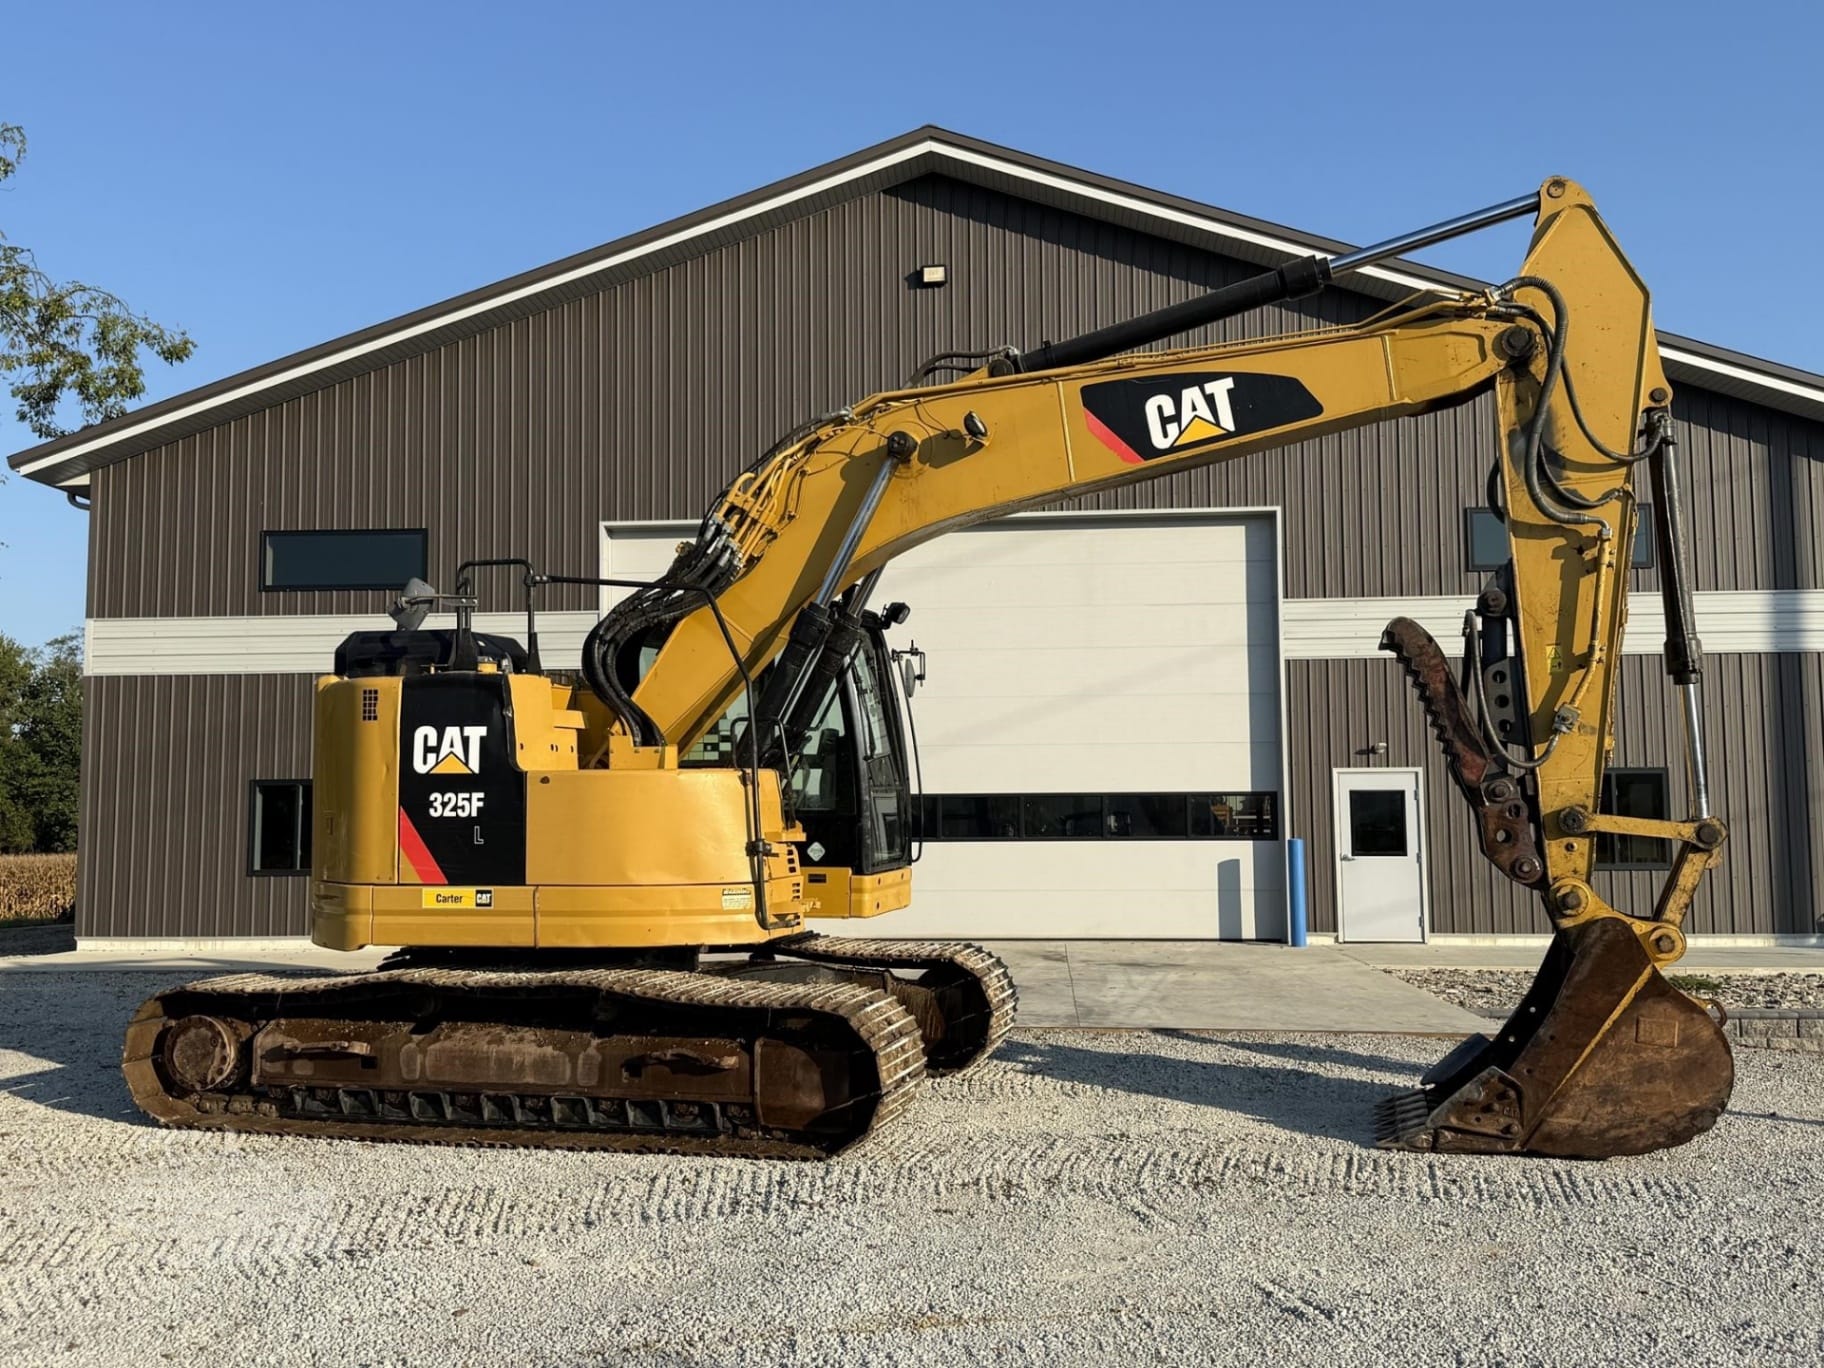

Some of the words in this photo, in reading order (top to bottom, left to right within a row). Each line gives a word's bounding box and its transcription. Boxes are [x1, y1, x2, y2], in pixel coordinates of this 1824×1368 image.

[1145, 377, 1235, 449] CAT
[413, 725, 487, 774] CAT
[429, 792, 485, 817] 325F
[474, 825, 484, 844] L
[436, 893, 463, 904] Carter
[476, 893, 491, 904] CAT
